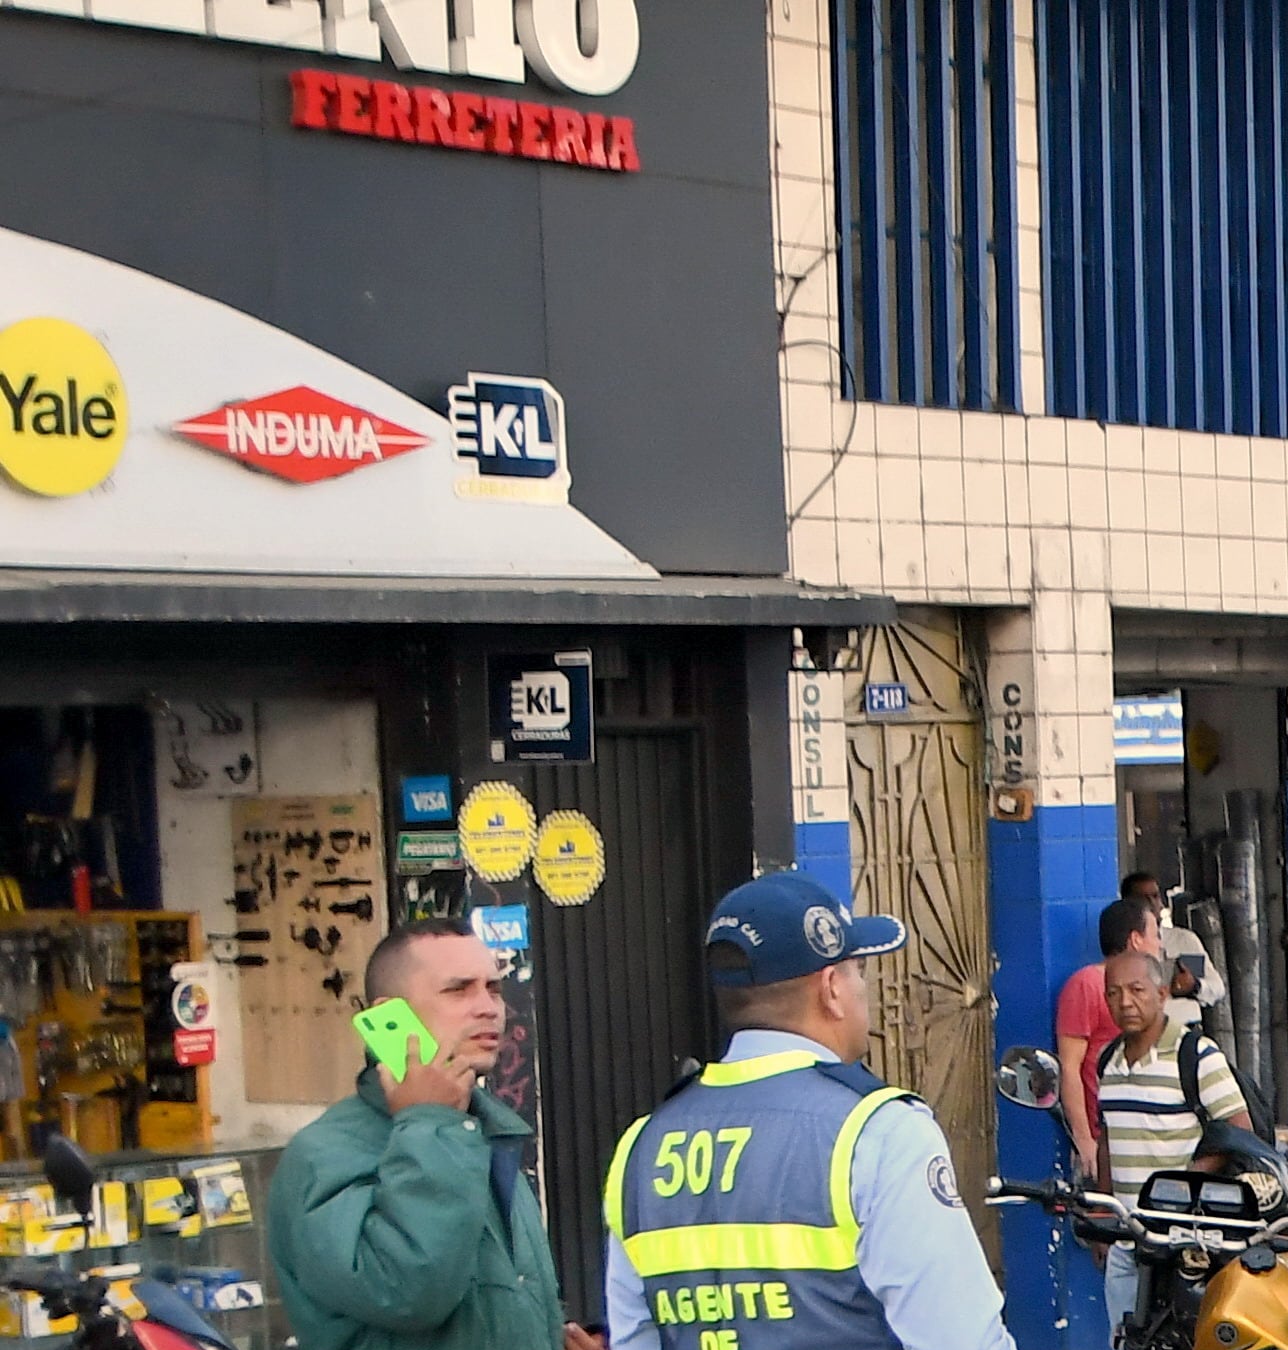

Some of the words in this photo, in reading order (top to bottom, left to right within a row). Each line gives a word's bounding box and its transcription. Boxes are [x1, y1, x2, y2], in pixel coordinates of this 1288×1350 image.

[290, 69, 640, 172] FERRETERIA
[0, 373, 116, 438] Yale
[226, 407, 384, 462] INDUMA
[411, 791, 448, 812] VISA
[484, 920, 524, 943] VISA
[653, 1126, 752, 1198] 507
[656, 1281, 795, 1326] AGENTE
